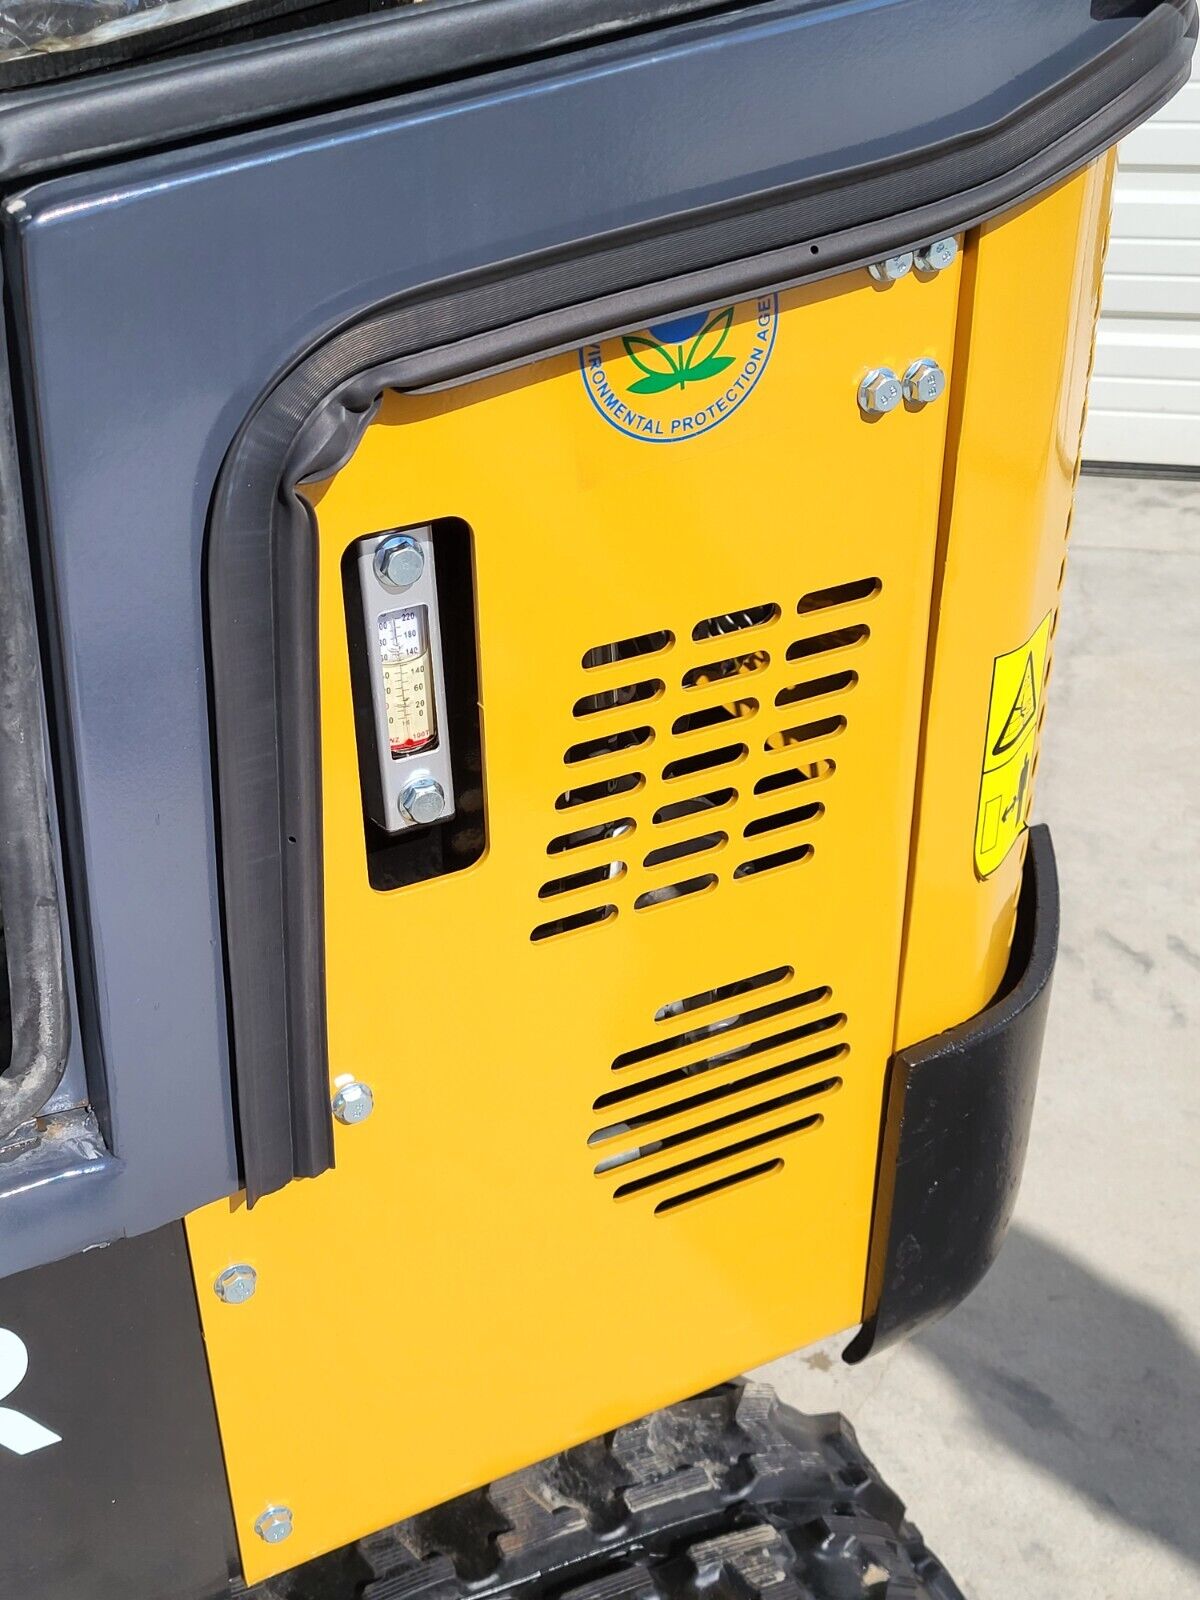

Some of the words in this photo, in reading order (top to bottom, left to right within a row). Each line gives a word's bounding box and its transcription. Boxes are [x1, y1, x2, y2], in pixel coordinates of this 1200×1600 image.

[670, 347, 764, 434] PROTECTION
[757, 296, 770, 341] AGE
[401, 612, 415, 621] 220
[403, 630, 417, 638] 180
[413, 683, 424, 692] 60
[415, 700, 425, 708] 20
